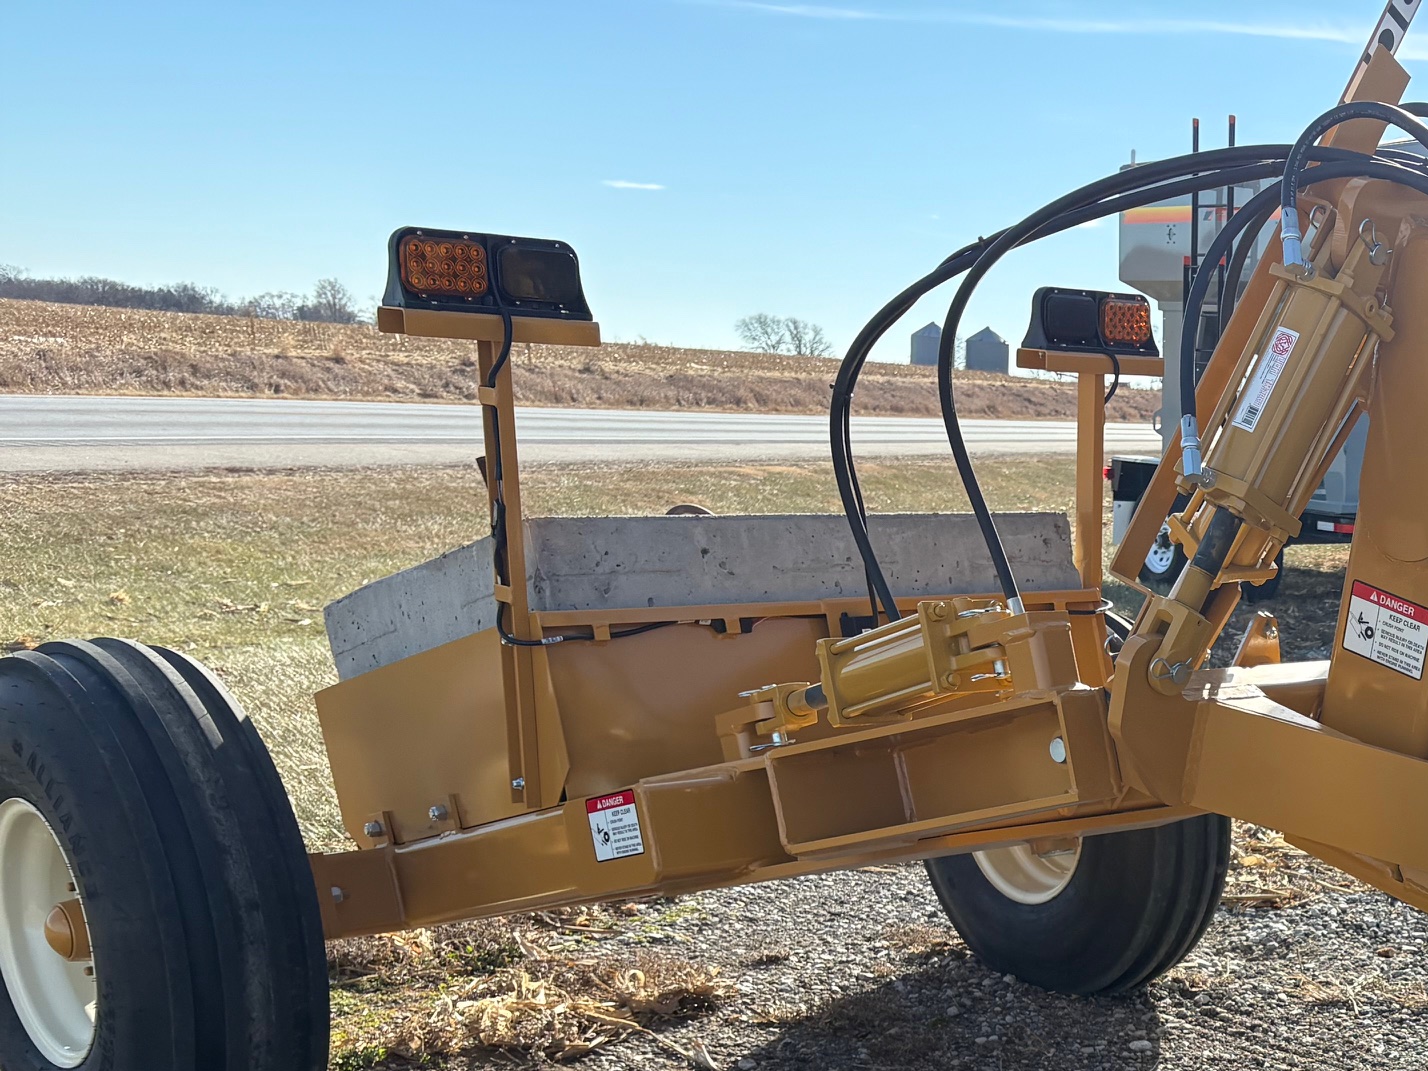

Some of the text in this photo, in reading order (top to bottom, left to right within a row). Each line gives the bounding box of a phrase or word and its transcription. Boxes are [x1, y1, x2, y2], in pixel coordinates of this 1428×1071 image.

[1379, 595, 1414, 616] DANGER
[1389, 614, 1420, 631] KEEP CLEAR
[601, 795, 623, 807] DANGER
